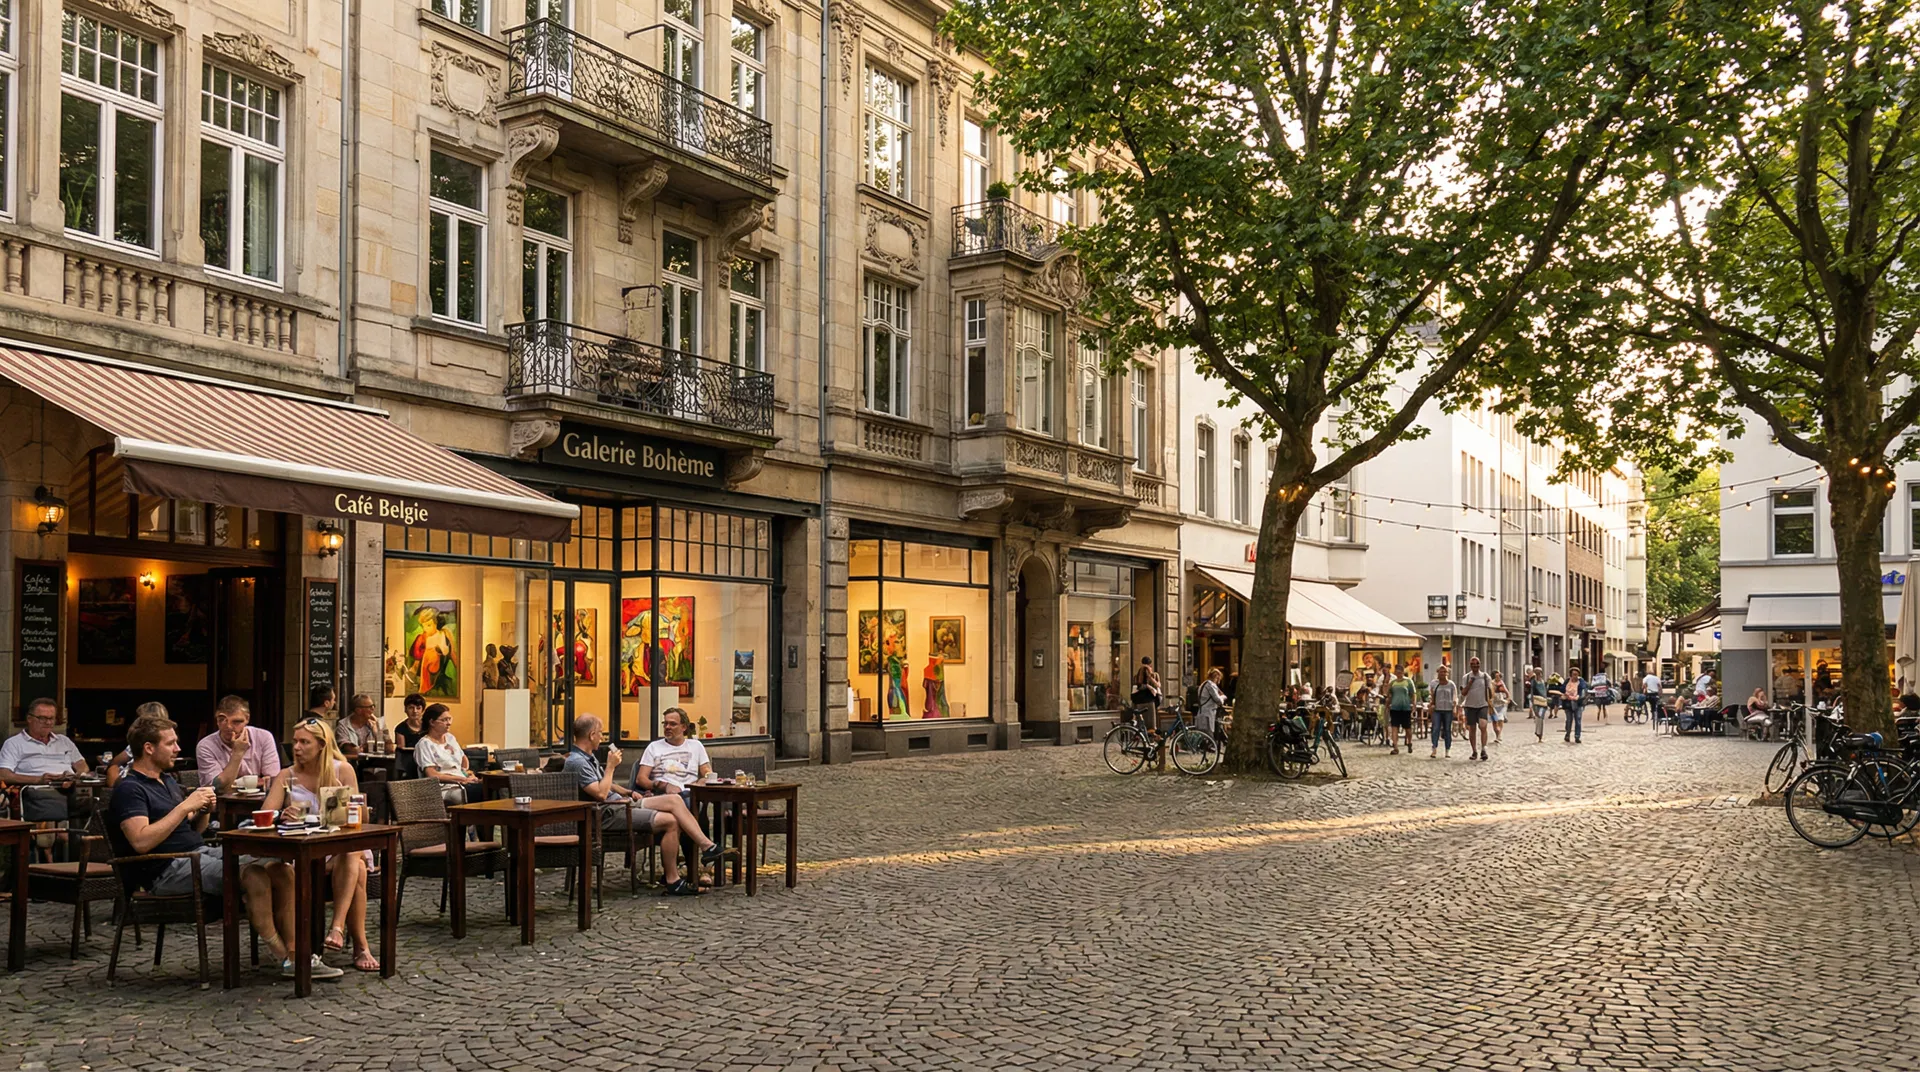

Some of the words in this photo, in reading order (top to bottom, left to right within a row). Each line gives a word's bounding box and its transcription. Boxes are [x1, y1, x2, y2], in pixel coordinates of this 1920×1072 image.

[562, 432, 636, 466] Galerie
[642, 444, 715, 478] Bohème
[334, 493, 373, 515] Café
[379, 498, 428, 525] Belgie
